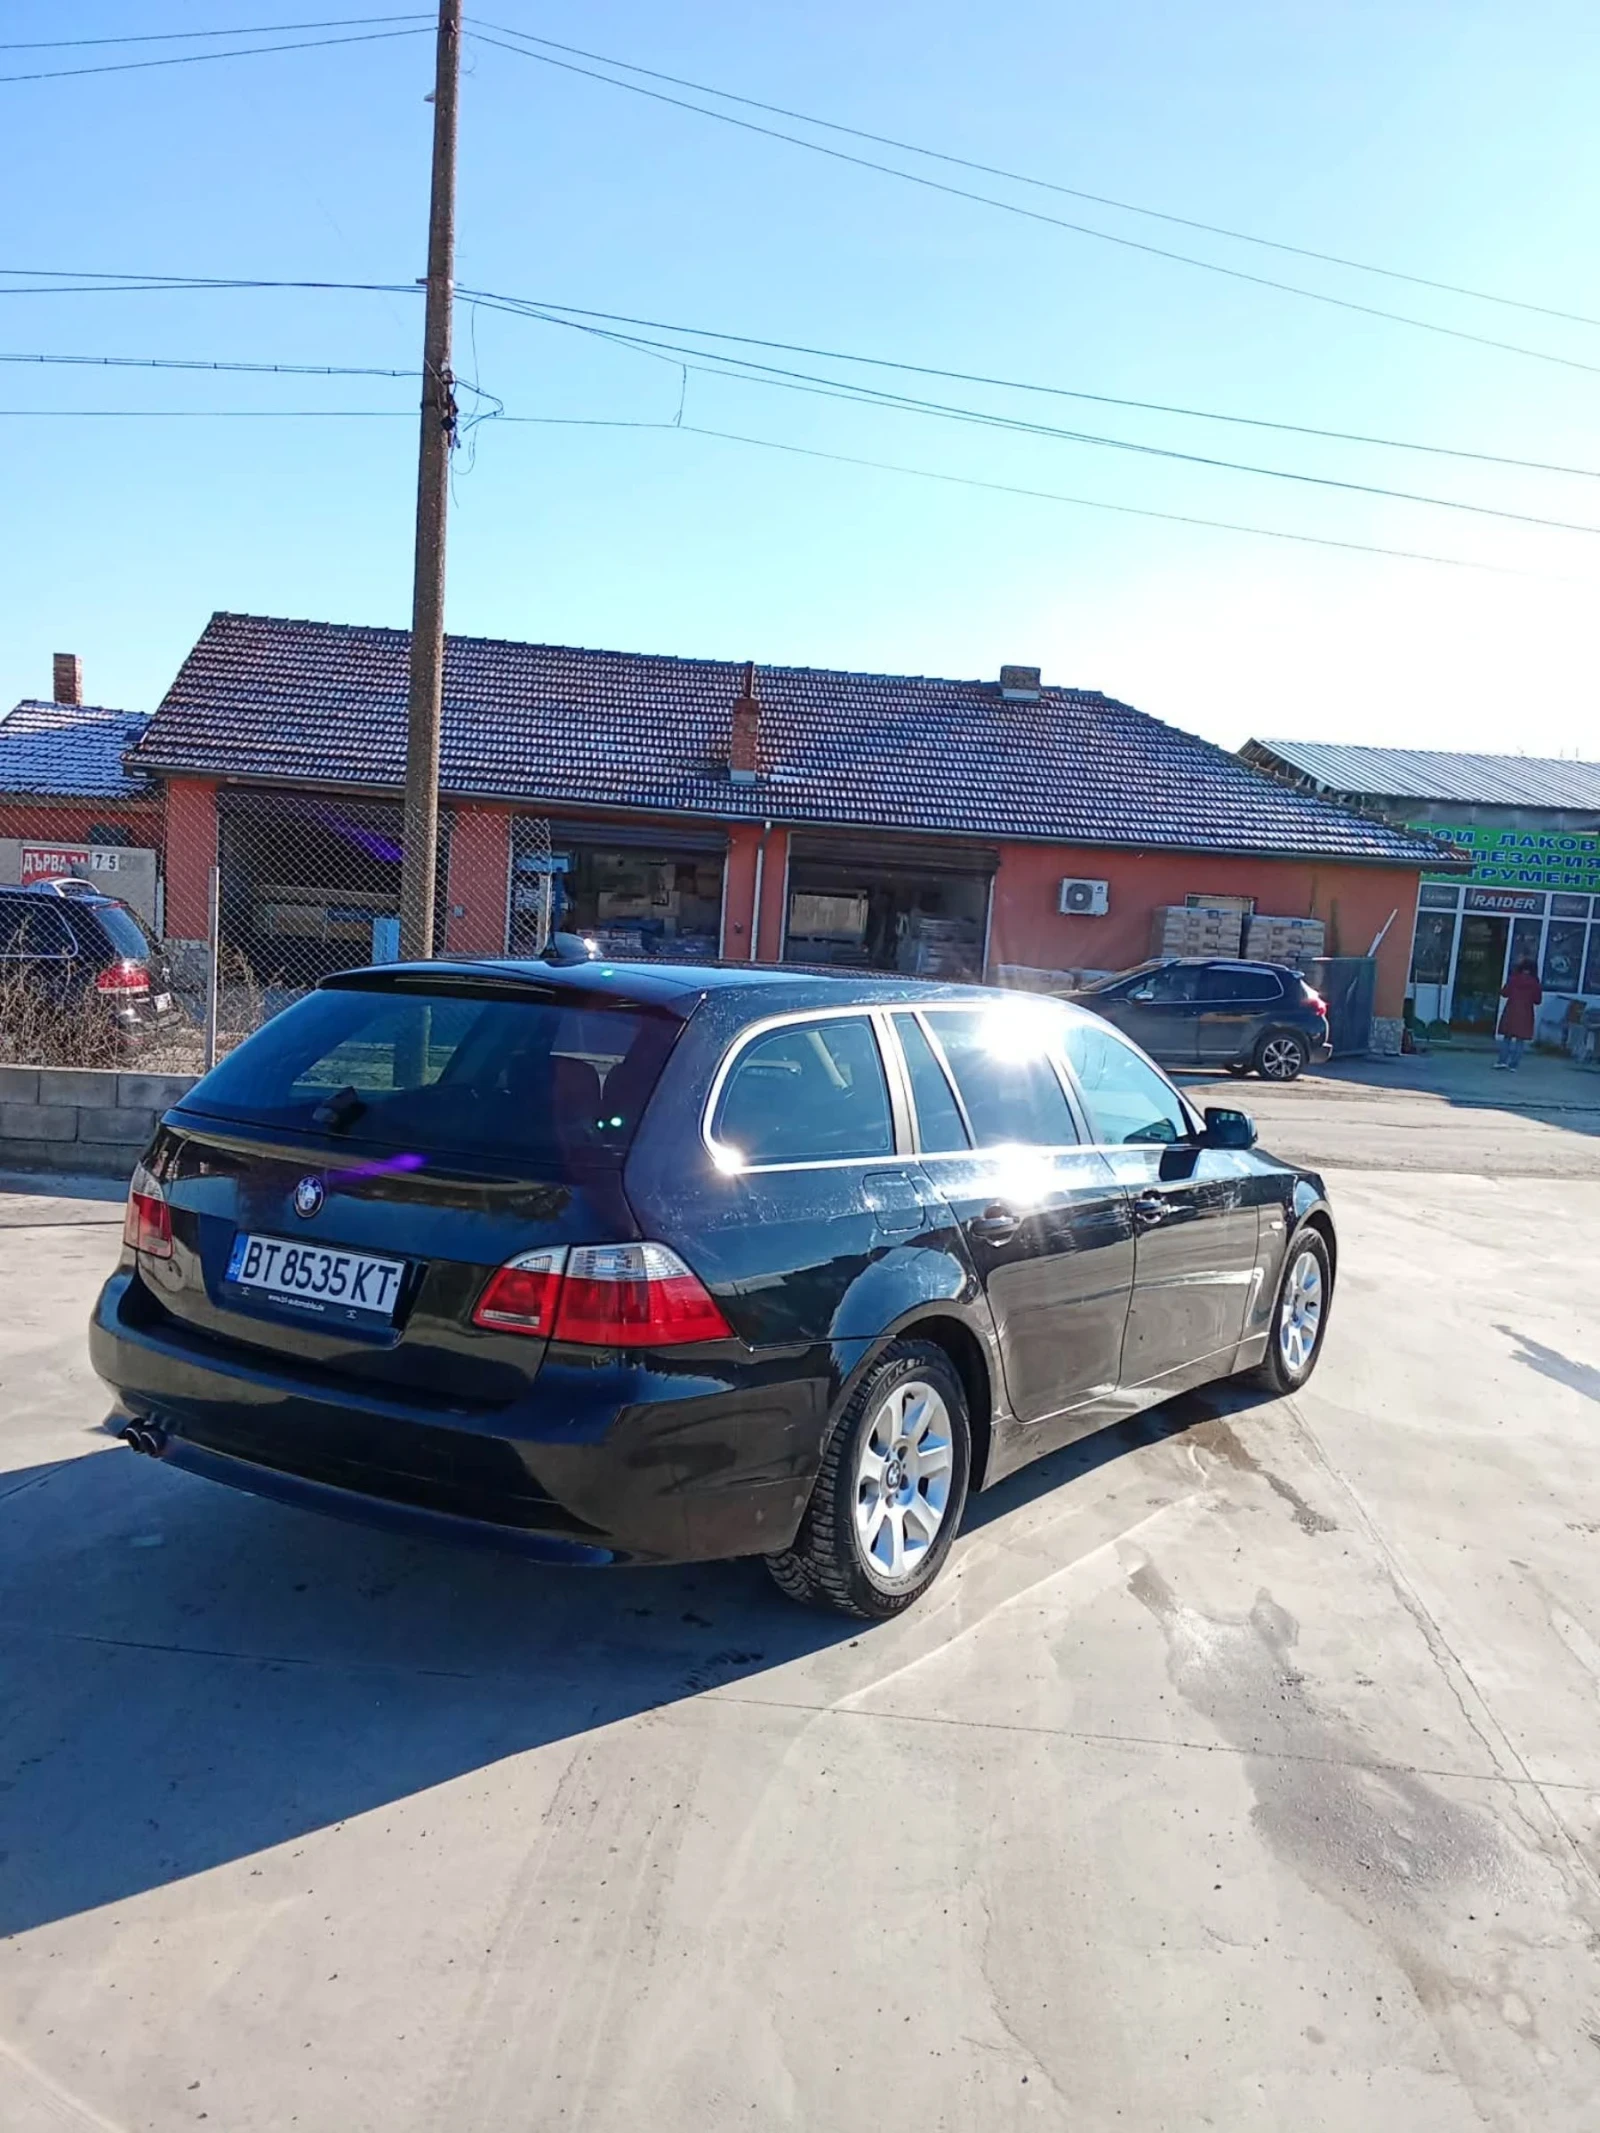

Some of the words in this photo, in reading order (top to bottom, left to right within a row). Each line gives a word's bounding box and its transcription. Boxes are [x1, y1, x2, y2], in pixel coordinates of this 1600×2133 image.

[1416, 827, 1475, 843] ОИ
[1456, 863, 1599, 887] ТРУМЕНТ
[1474, 894, 1536, 910] RAIDER
[243, 1241, 281, 1282] BT
[280, 1249, 350, 1296] 8535
[350, 1261, 398, 1305] KT
